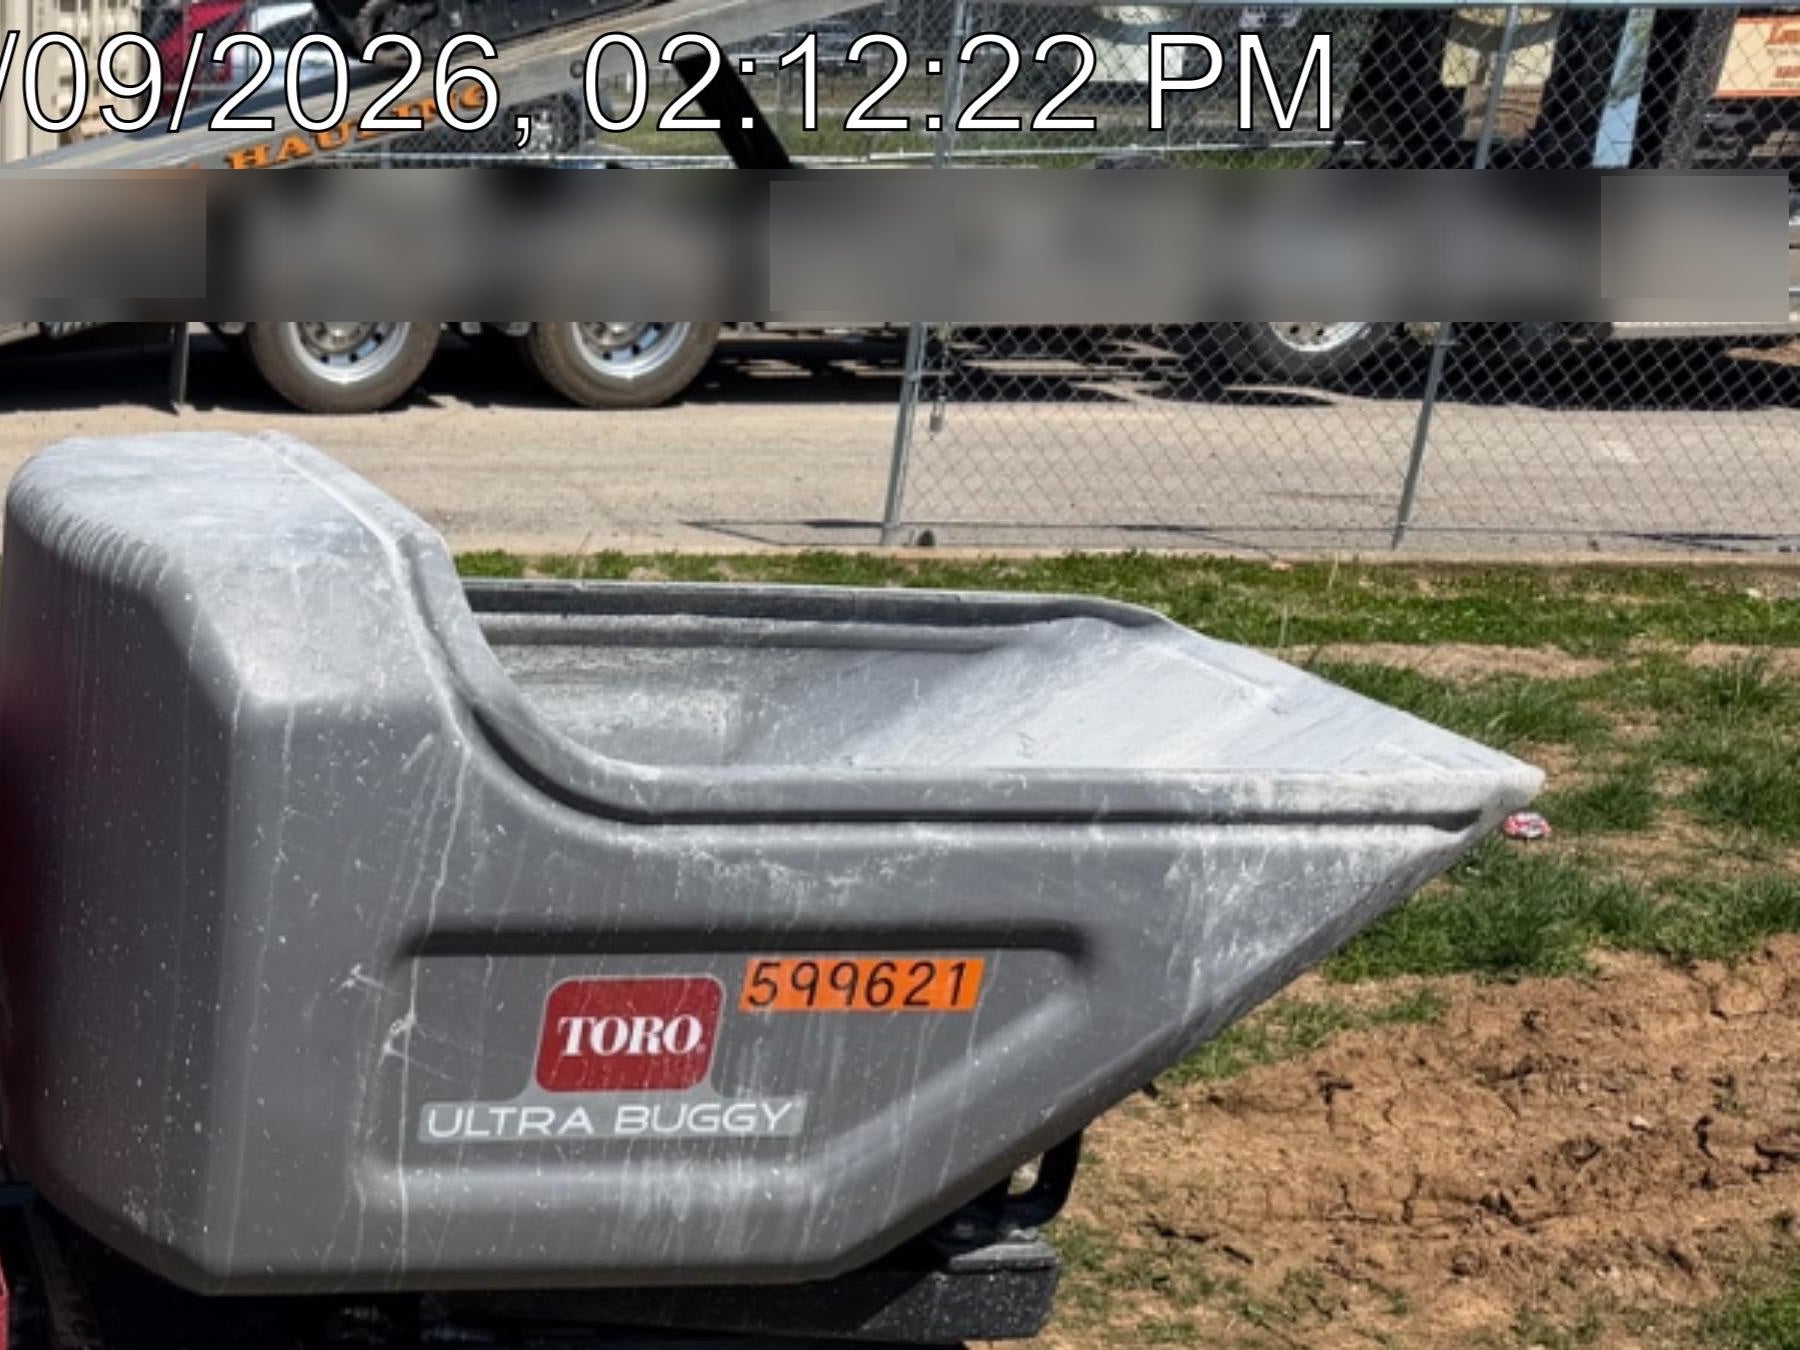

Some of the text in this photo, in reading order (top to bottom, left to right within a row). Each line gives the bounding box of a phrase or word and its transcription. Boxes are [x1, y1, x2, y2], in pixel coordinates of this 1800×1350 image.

[746, 960, 968, 1008] 599621
[556, 1012, 705, 1058] TORO
[427, 1099, 794, 1139] ULTRA BUGGY
